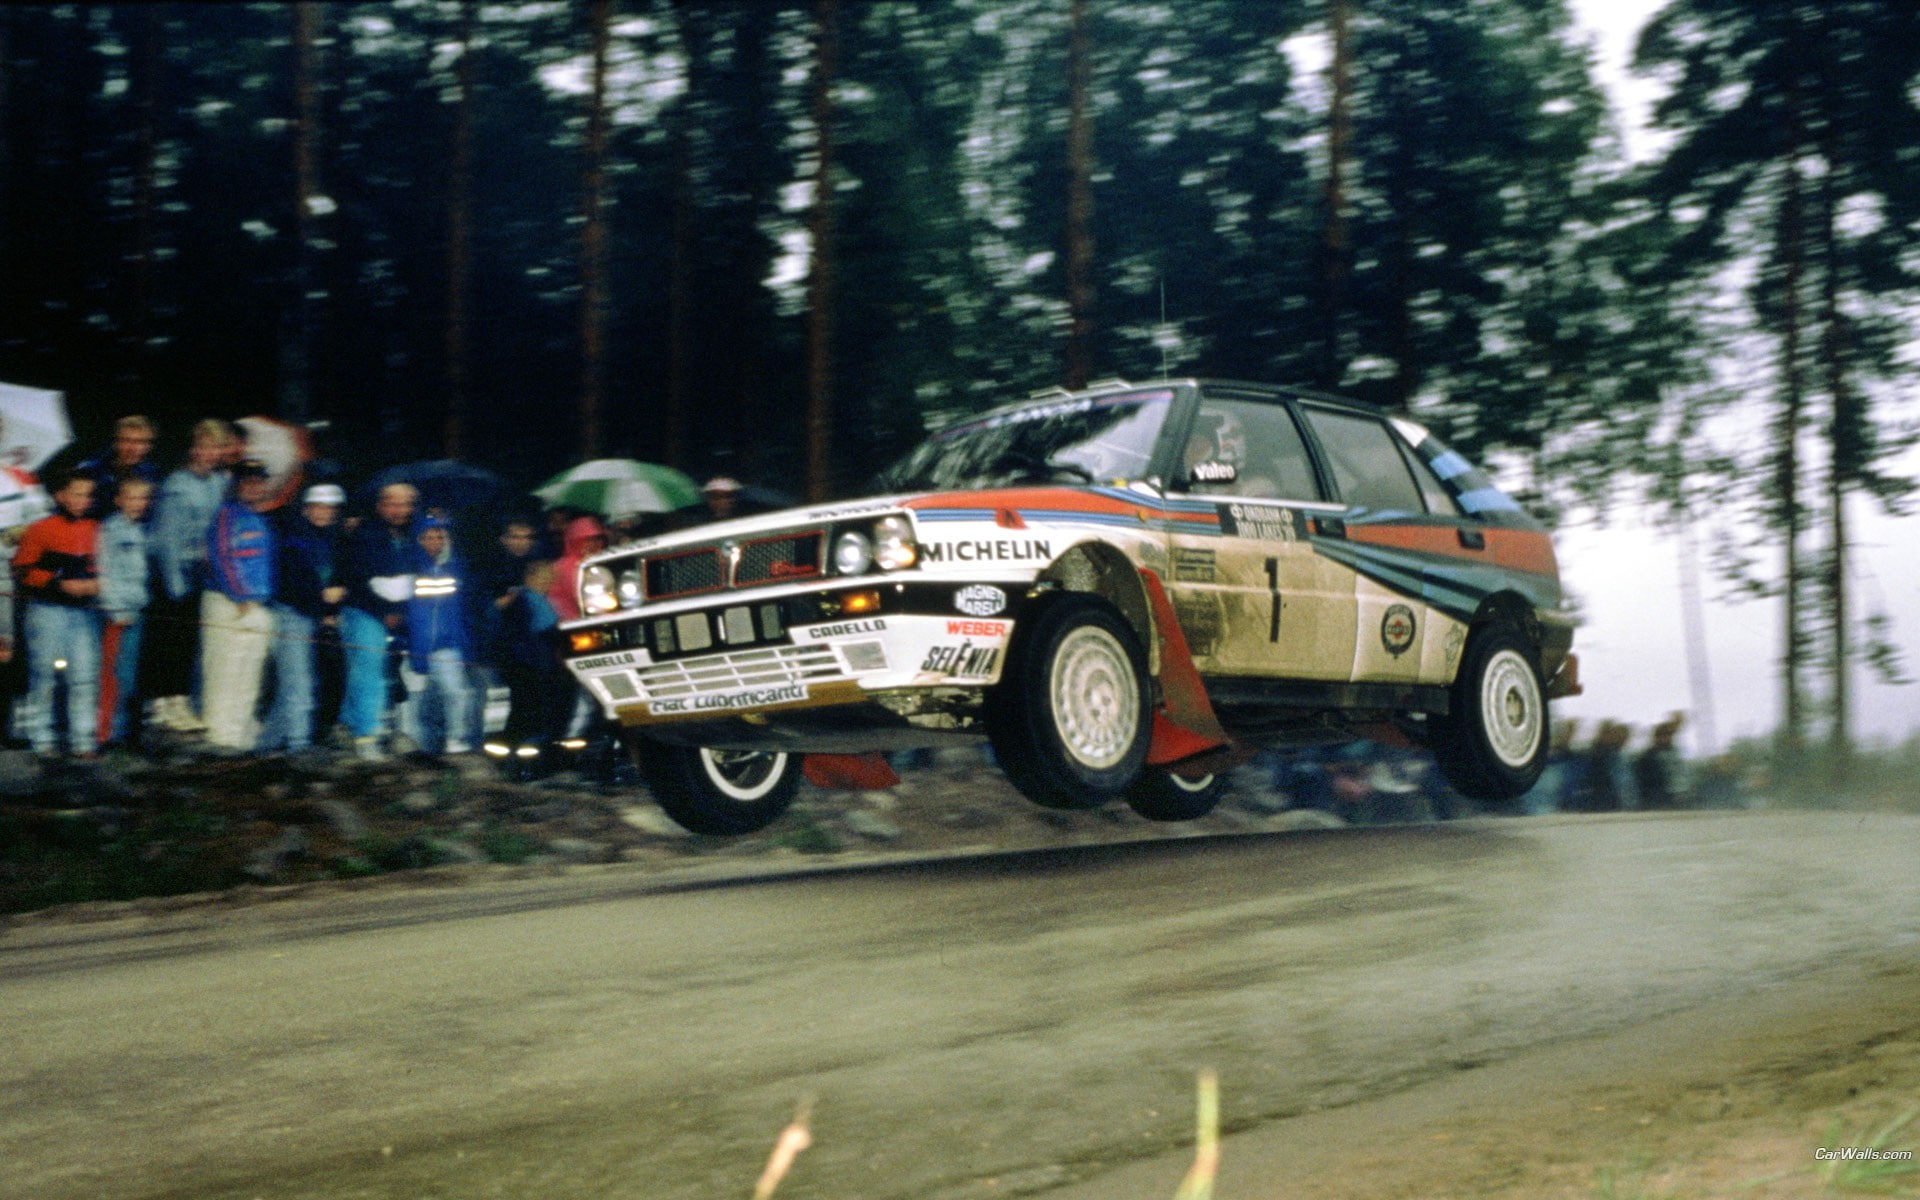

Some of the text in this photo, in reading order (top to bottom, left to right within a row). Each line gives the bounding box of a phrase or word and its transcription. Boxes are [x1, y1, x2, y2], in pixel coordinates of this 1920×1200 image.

[918, 540, 1052, 562] MICHELIN
[1264, 557, 1281, 643] 1
[808, 619, 888, 639] CARELLO
[946, 621, 1006, 637] WEBER
[575, 653, 636, 671] CARELLO
